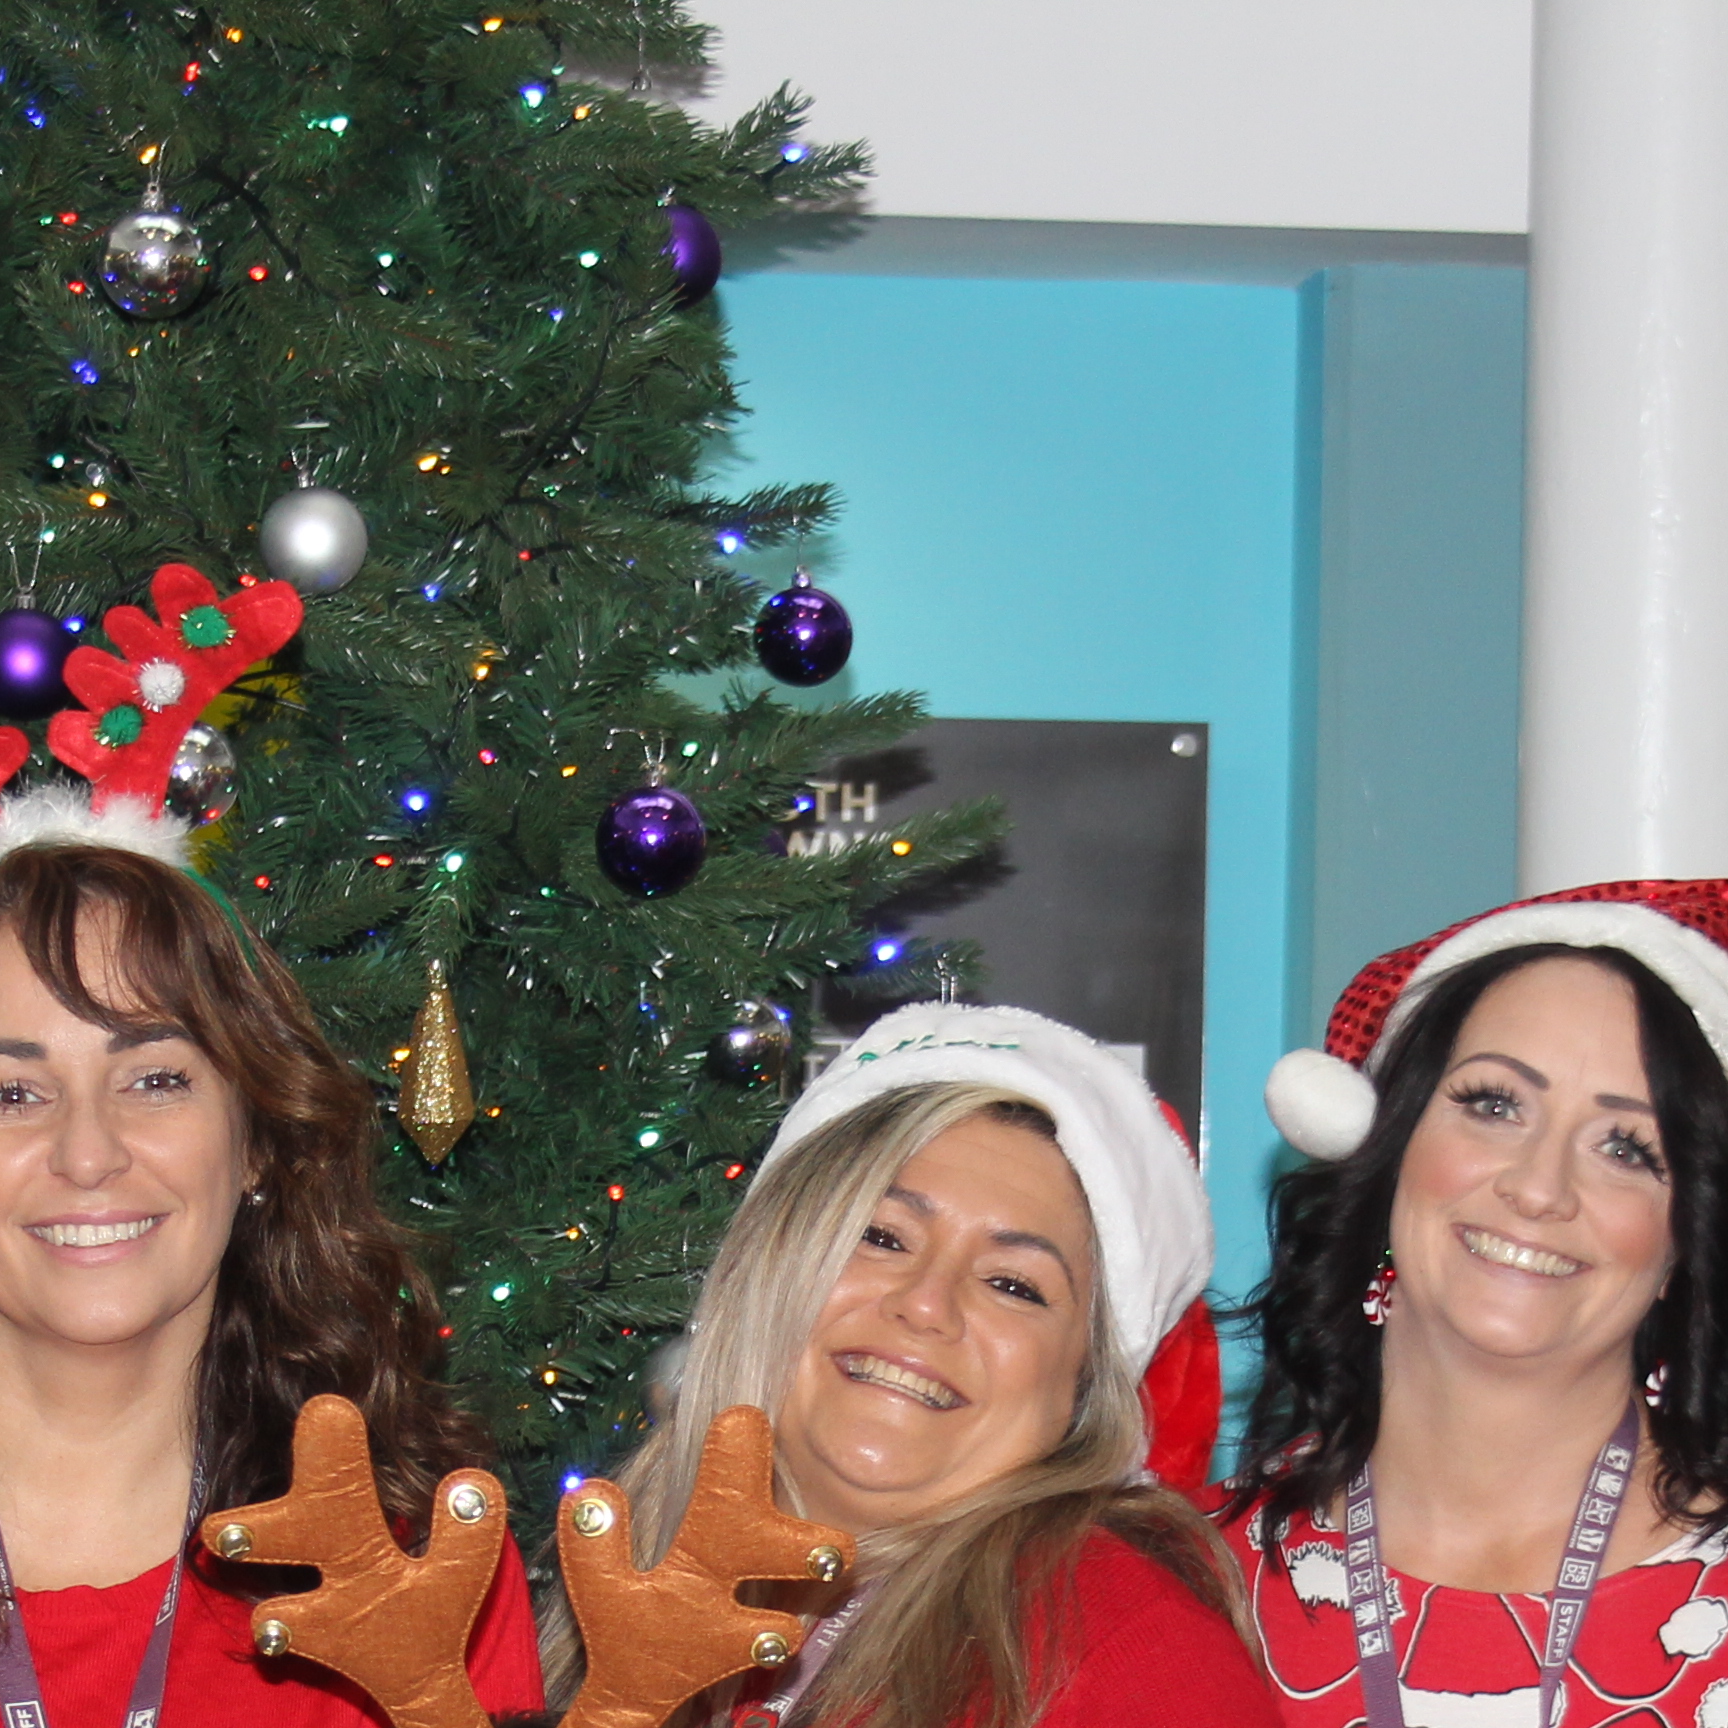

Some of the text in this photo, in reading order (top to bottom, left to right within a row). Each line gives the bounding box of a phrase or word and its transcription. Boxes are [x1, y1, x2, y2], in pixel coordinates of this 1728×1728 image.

[1563, 1564, 1576, 1584] DC
[1574, 1565, 1589, 1584] HS
[1550, 1604, 1573, 1661] STAFF
